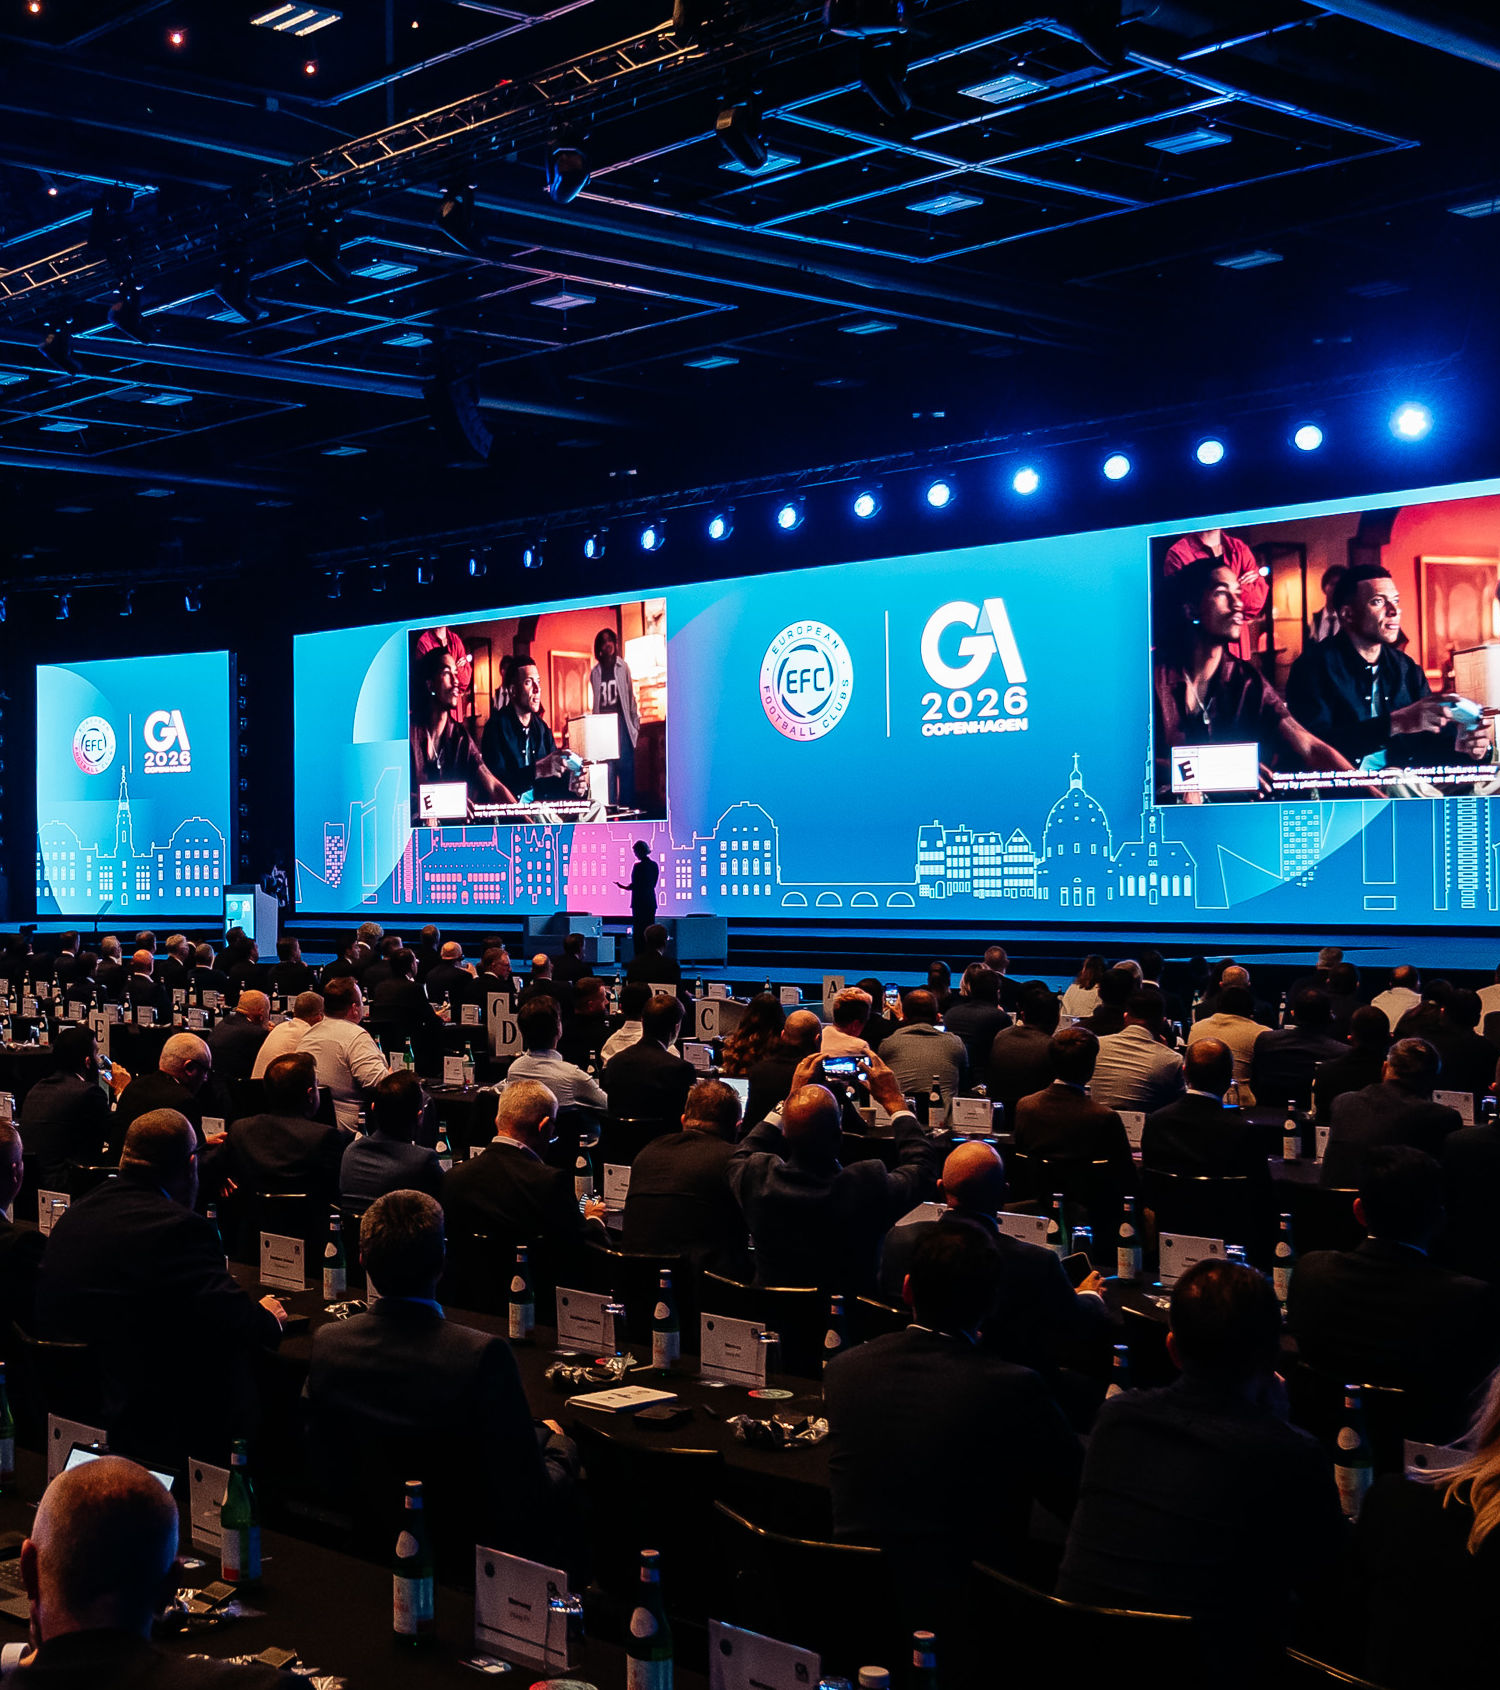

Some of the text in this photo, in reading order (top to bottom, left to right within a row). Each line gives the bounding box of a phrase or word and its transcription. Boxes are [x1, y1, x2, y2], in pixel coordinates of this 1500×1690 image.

[772, 625, 840, 655] EUROPEAN
[920, 597, 1028, 689] GA
[786, 667, 825, 694] EFC
[764, 679, 849, 736] FOOTBALL CLUBS
[921, 686, 1028, 720] 2026
[143, 709, 191, 752] GA
[921, 718, 1028, 736] COPENHAGEN
[85, 739, 103, 752] EFC
[144, 750, 191, 767] 2026
[1177, 760, 1195, 782] E
[423, 795, 433, 811] E
[827, 980, 837, 999] A
[95, 1019, 104, 1042] E
[701, 1008, 714, 1030] C
[502, 1020, 517, 1044] D
